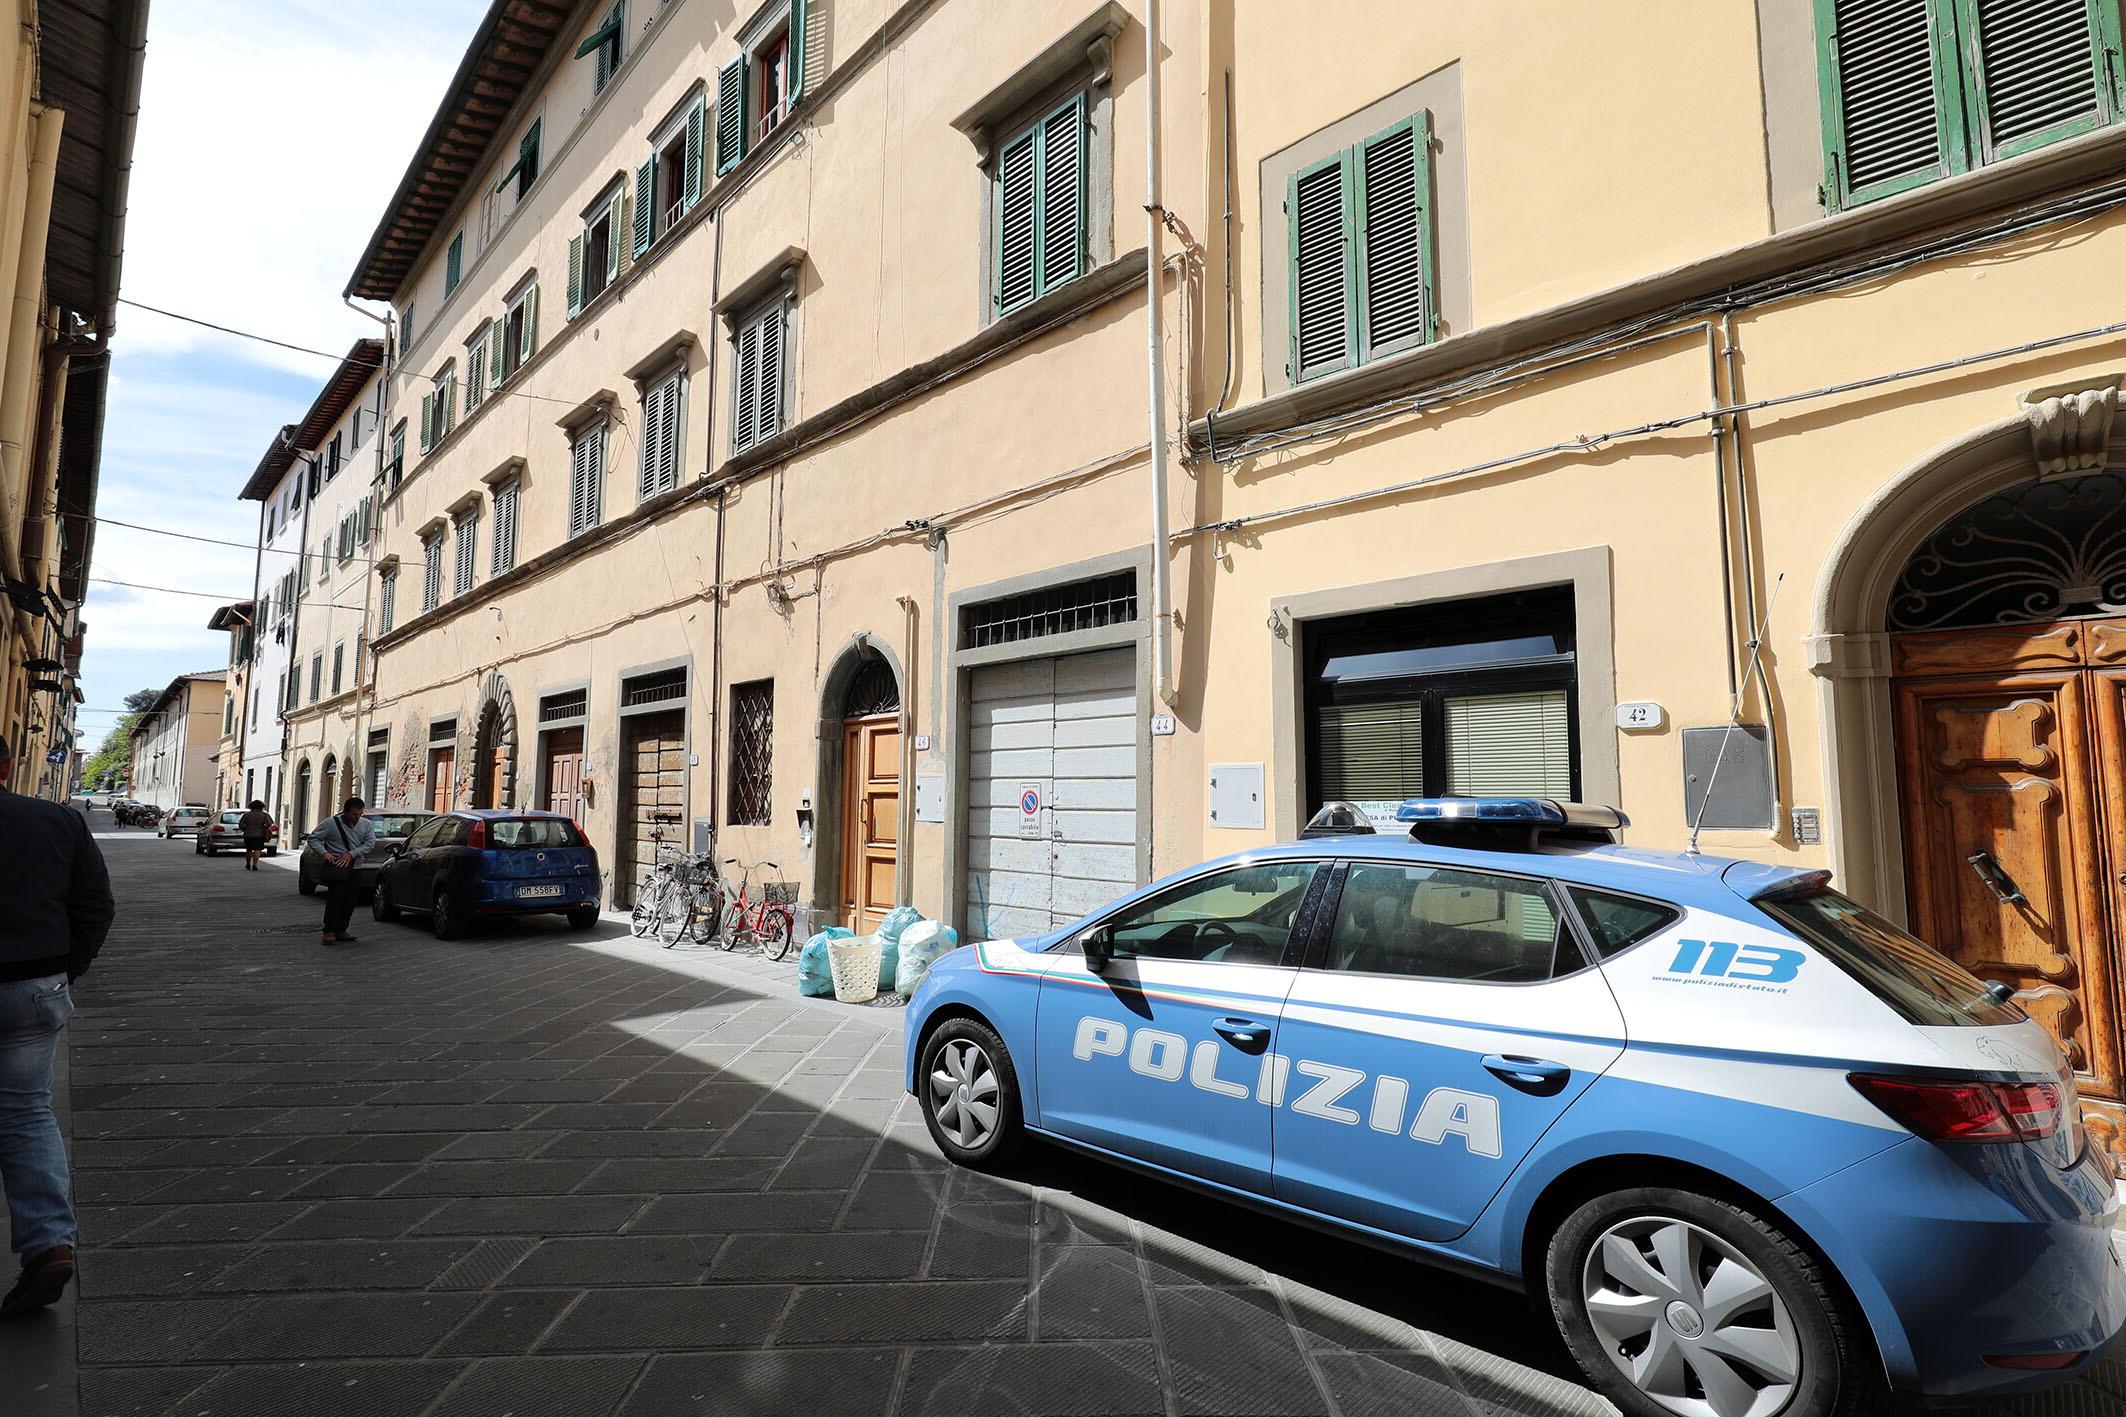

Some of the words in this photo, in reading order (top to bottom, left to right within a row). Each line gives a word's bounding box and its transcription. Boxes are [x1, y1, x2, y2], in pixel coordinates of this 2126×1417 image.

[1629, 708, 1646, 721] 42
[1156, 719, 1168, 731] 44
[521, 887, 532, 896] DM
[534, 885, 559, 895] 558FV
[1668, 938, 1807, 983] 113
[1651, 975, 1789, 994] www.poliziadistato.it
[1072, 1015, 1503, 1160] POLIZIA
